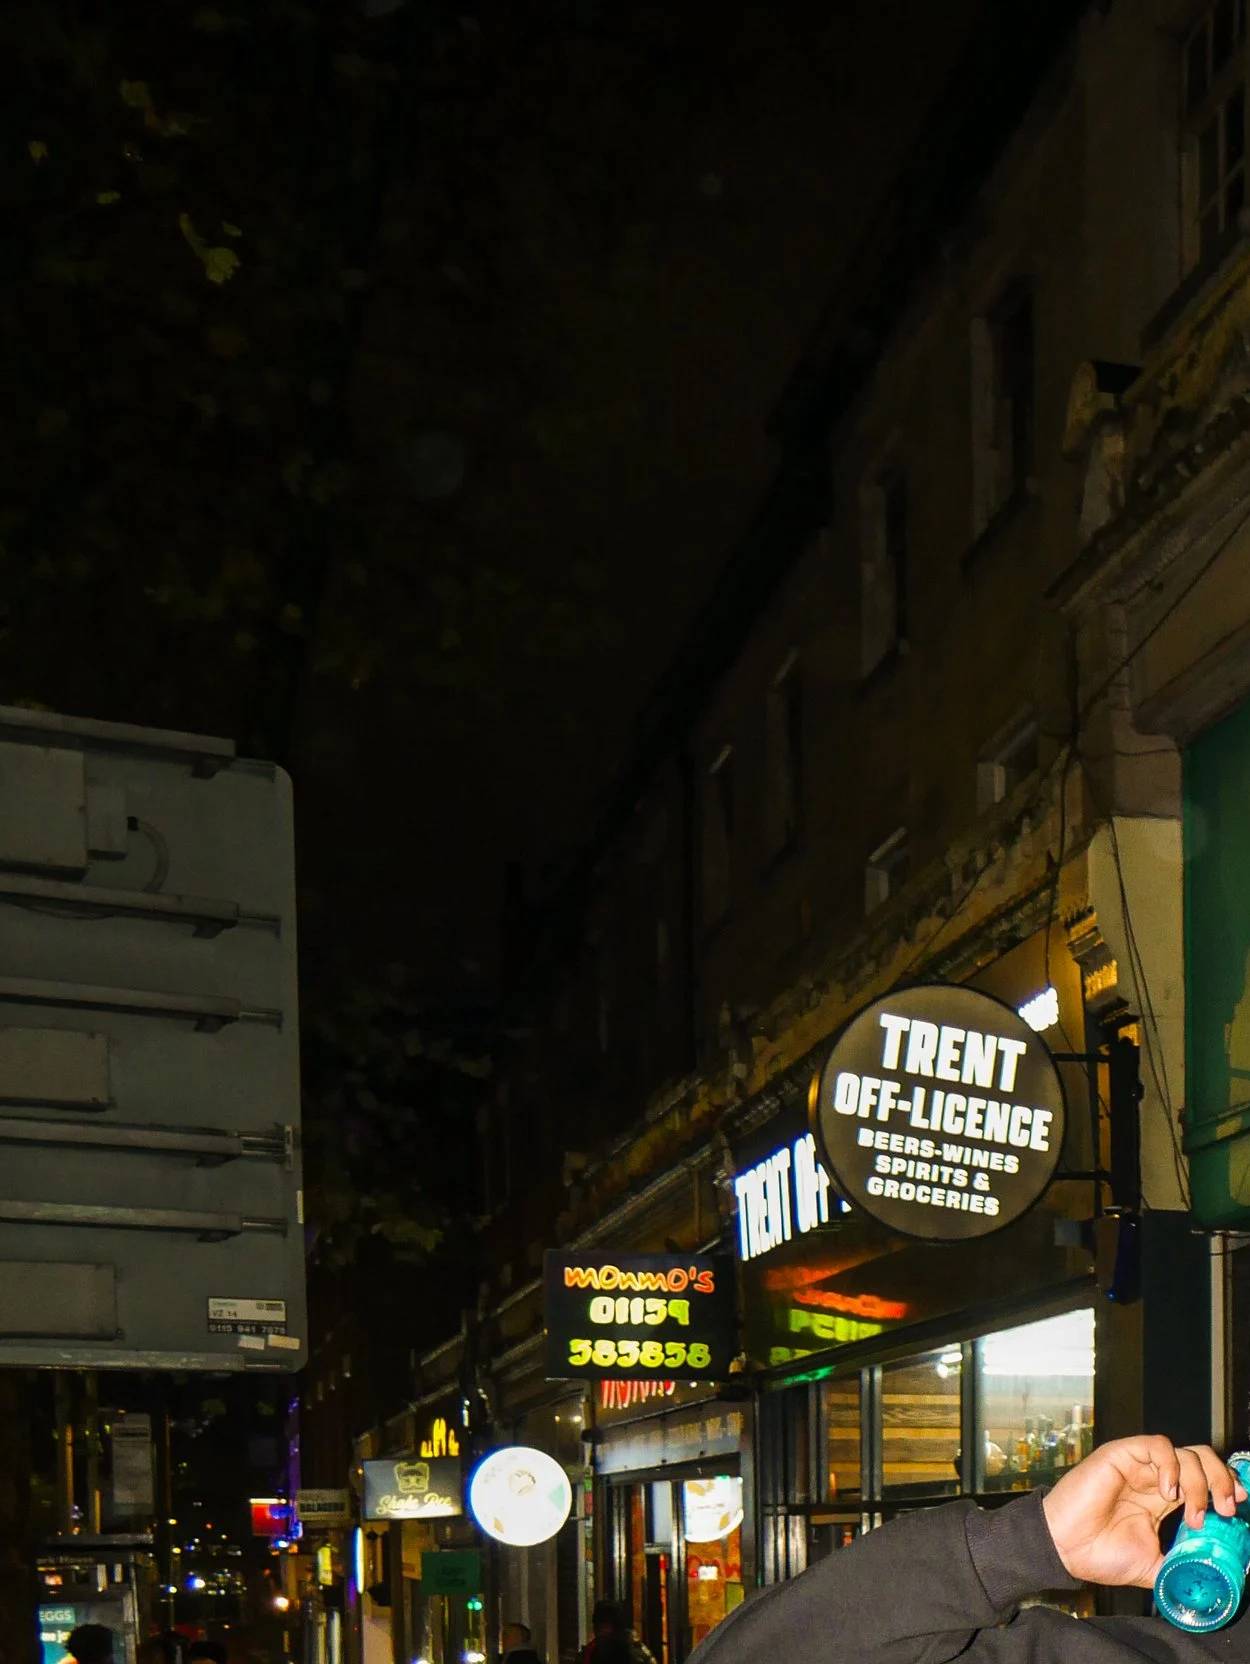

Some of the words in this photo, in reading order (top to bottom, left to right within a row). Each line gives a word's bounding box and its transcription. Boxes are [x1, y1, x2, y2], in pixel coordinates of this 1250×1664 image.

[880, 1012, 1027, 1093] TRENT
[833, 1072, 1053, 1152] OFF-LICENCE
[857, 1127, 1020, 1174] BEERS-WINES
[874, 1154, 969, 1188] SPIRITS
[972, 1172, 991, 1192] &
[734, 1147, 792, 1261] TRENT
[866, 1175, 1001, 1216] GROCERIES
[589, 1296, 691, 1326] 01159
[568, 1338, 712, 1369] 585858
